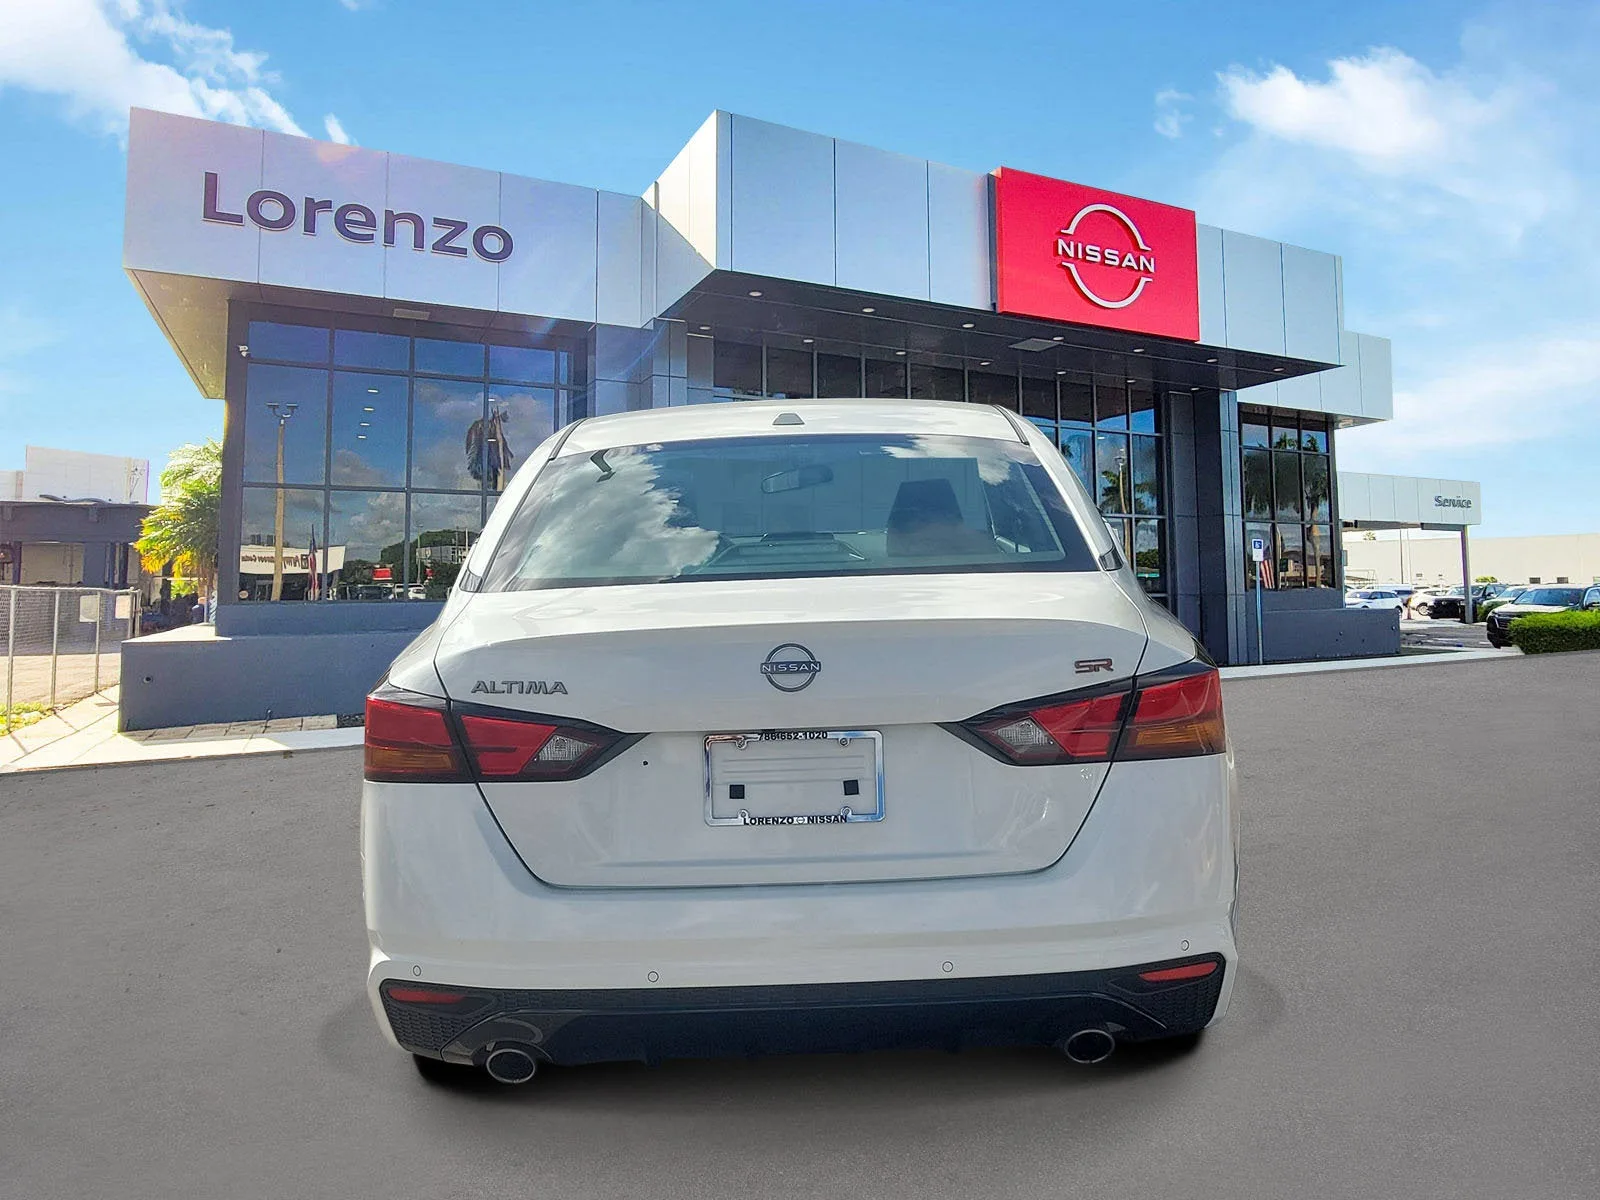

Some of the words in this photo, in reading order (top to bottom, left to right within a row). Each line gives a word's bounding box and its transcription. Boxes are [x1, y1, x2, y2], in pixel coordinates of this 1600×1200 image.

[203, 171, 514, 262] Lorenzo
[1057, 238, 1155, 272] NISSAN
[1434, 495, 1472, 508] Service
[762, 663, 820, 672] NISSAN
[1074, 658, 1114, 674] SR
[471, 680, 568, 695] ALTIMA
[743, 815, 794, 825] LORENZO
[807, 814, 848, 824] NISSAN
